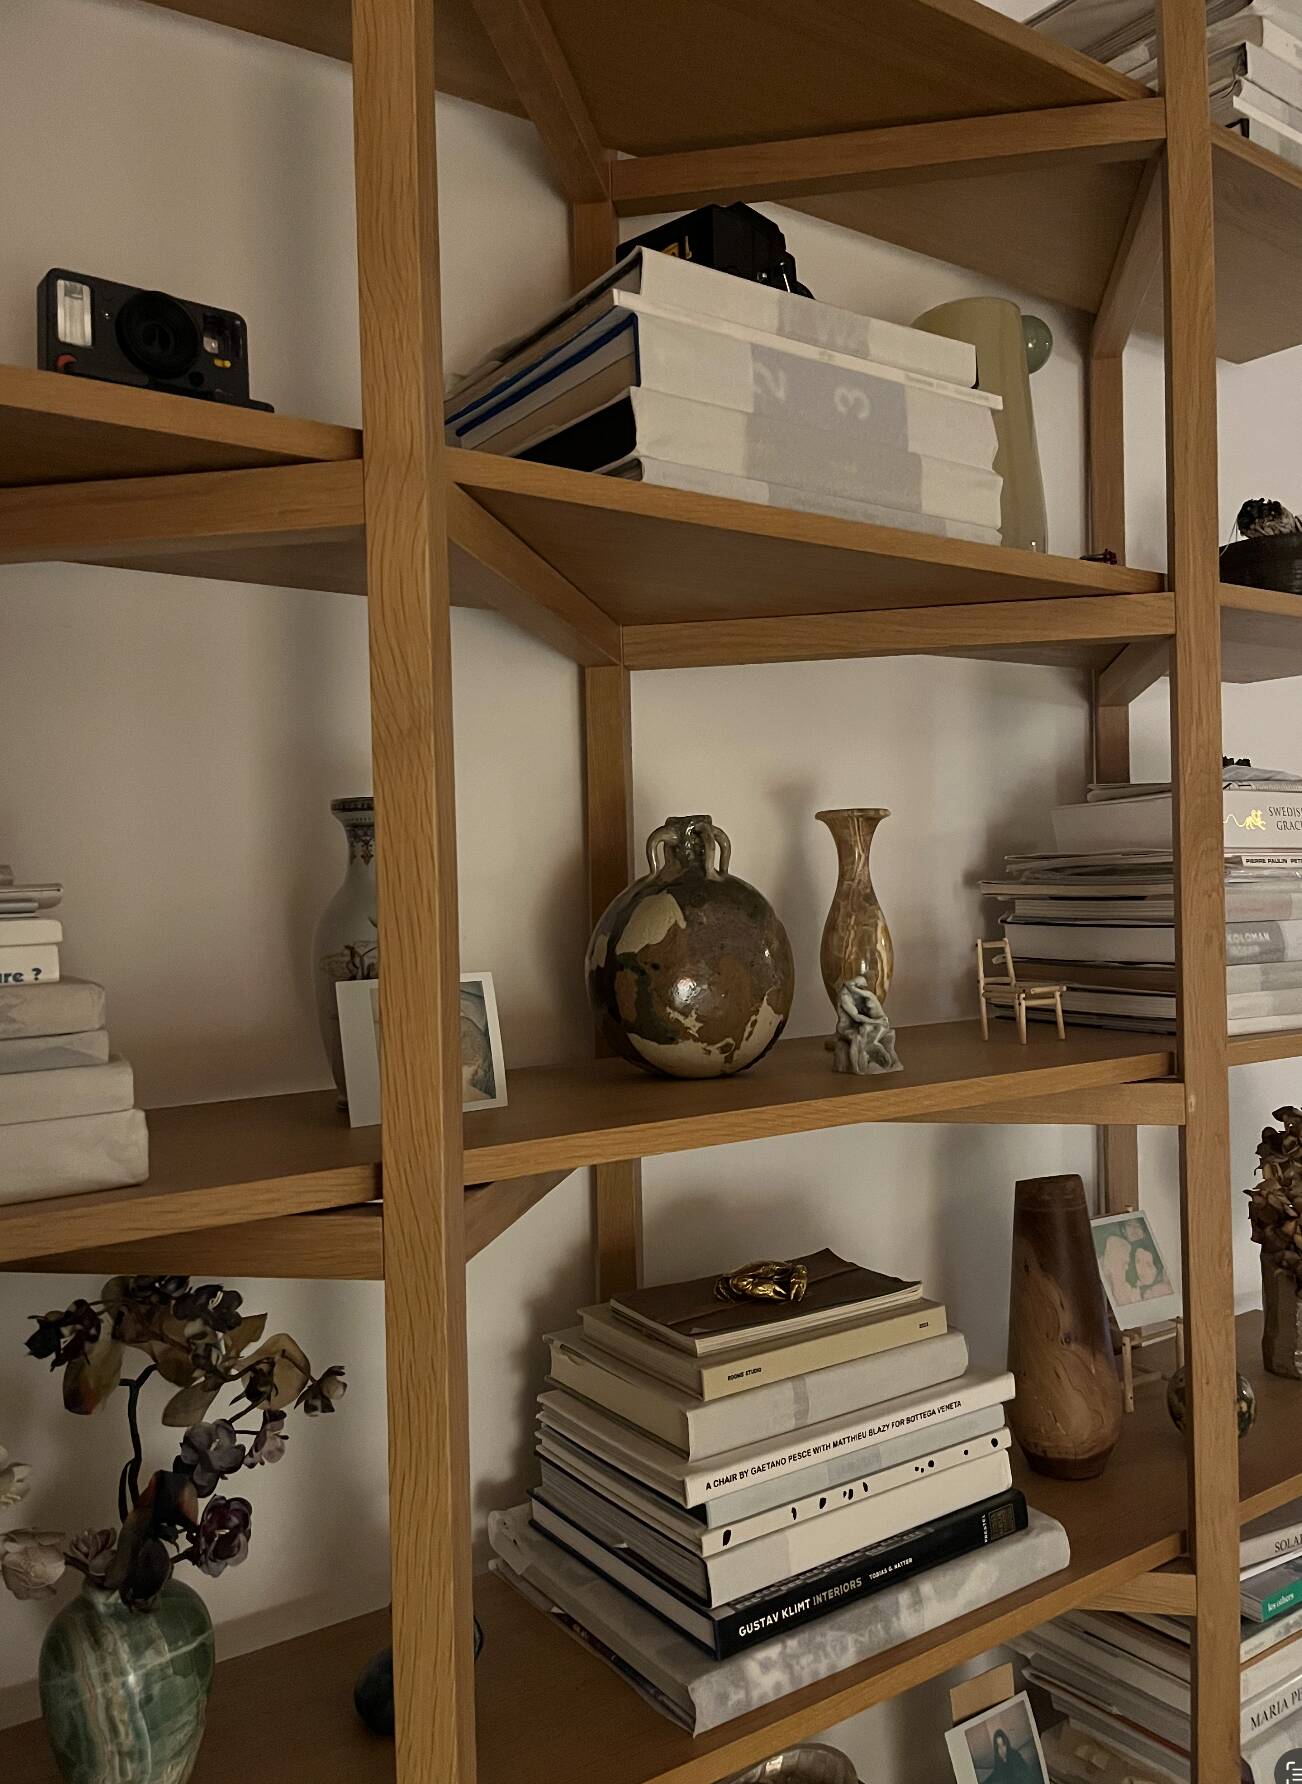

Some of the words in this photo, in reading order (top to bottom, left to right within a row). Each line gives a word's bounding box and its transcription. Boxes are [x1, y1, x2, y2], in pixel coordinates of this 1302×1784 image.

[1268, 806, 1302, 817] SWEDIS
[745, 1367, 762, 1376] STUDIO
[705, 1482, 712, 1490] A
[713, 1473, 738, 1488] CHAIR
[739, 1469, 749, 1480] BY
[750, 1457, 787, 1475] GAETANO
[788, 1449, 812, 1463] PESCE
[812, 1442, 831, 1455] WITH
[832, 1431, 867, 1448] MATTHIEU
[868, 1423, 890, 1437] BLAZY
[891, 1418, 905, 1429] FOR
[906, 1409, 937, 1425] BOTTEGA
[937, 1400, 962, 1414] VENETA
[738, 1611, 780, 1637] GUSTAV
[781, 1598, 811, 1619] KLIMT
[812, 1577, 863, 1606] INTERIORS
[868, 1567, 888, 1580] TOBIAS
[894, 1557, 913, 1569] NATTER
[1250, 1697, 1289, 1731] MARIA
